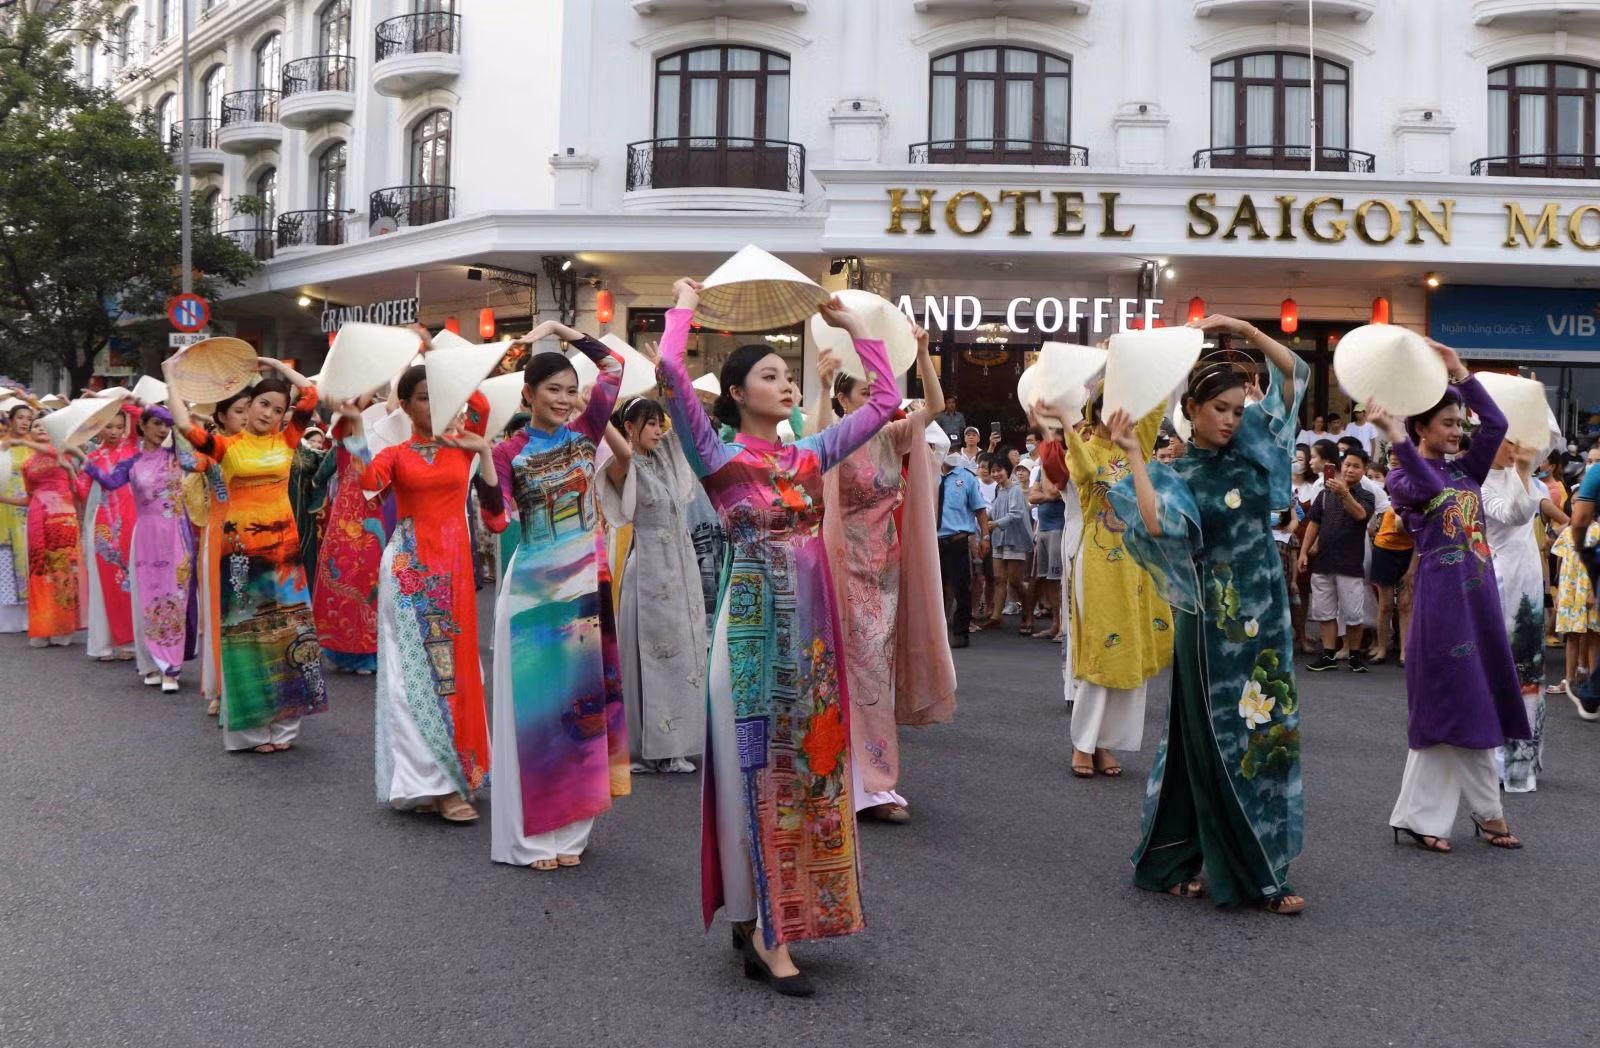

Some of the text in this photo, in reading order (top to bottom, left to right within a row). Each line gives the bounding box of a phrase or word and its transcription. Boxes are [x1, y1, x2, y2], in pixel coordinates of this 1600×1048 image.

[886, 188, 1600, 251] HOTEL SAIGON MO
[321, 298, 416, 332] GRAND COFFEE
[898, 295, 1164, 333] AND COFFEE
[1547, 314, 1596, 337] VIB
